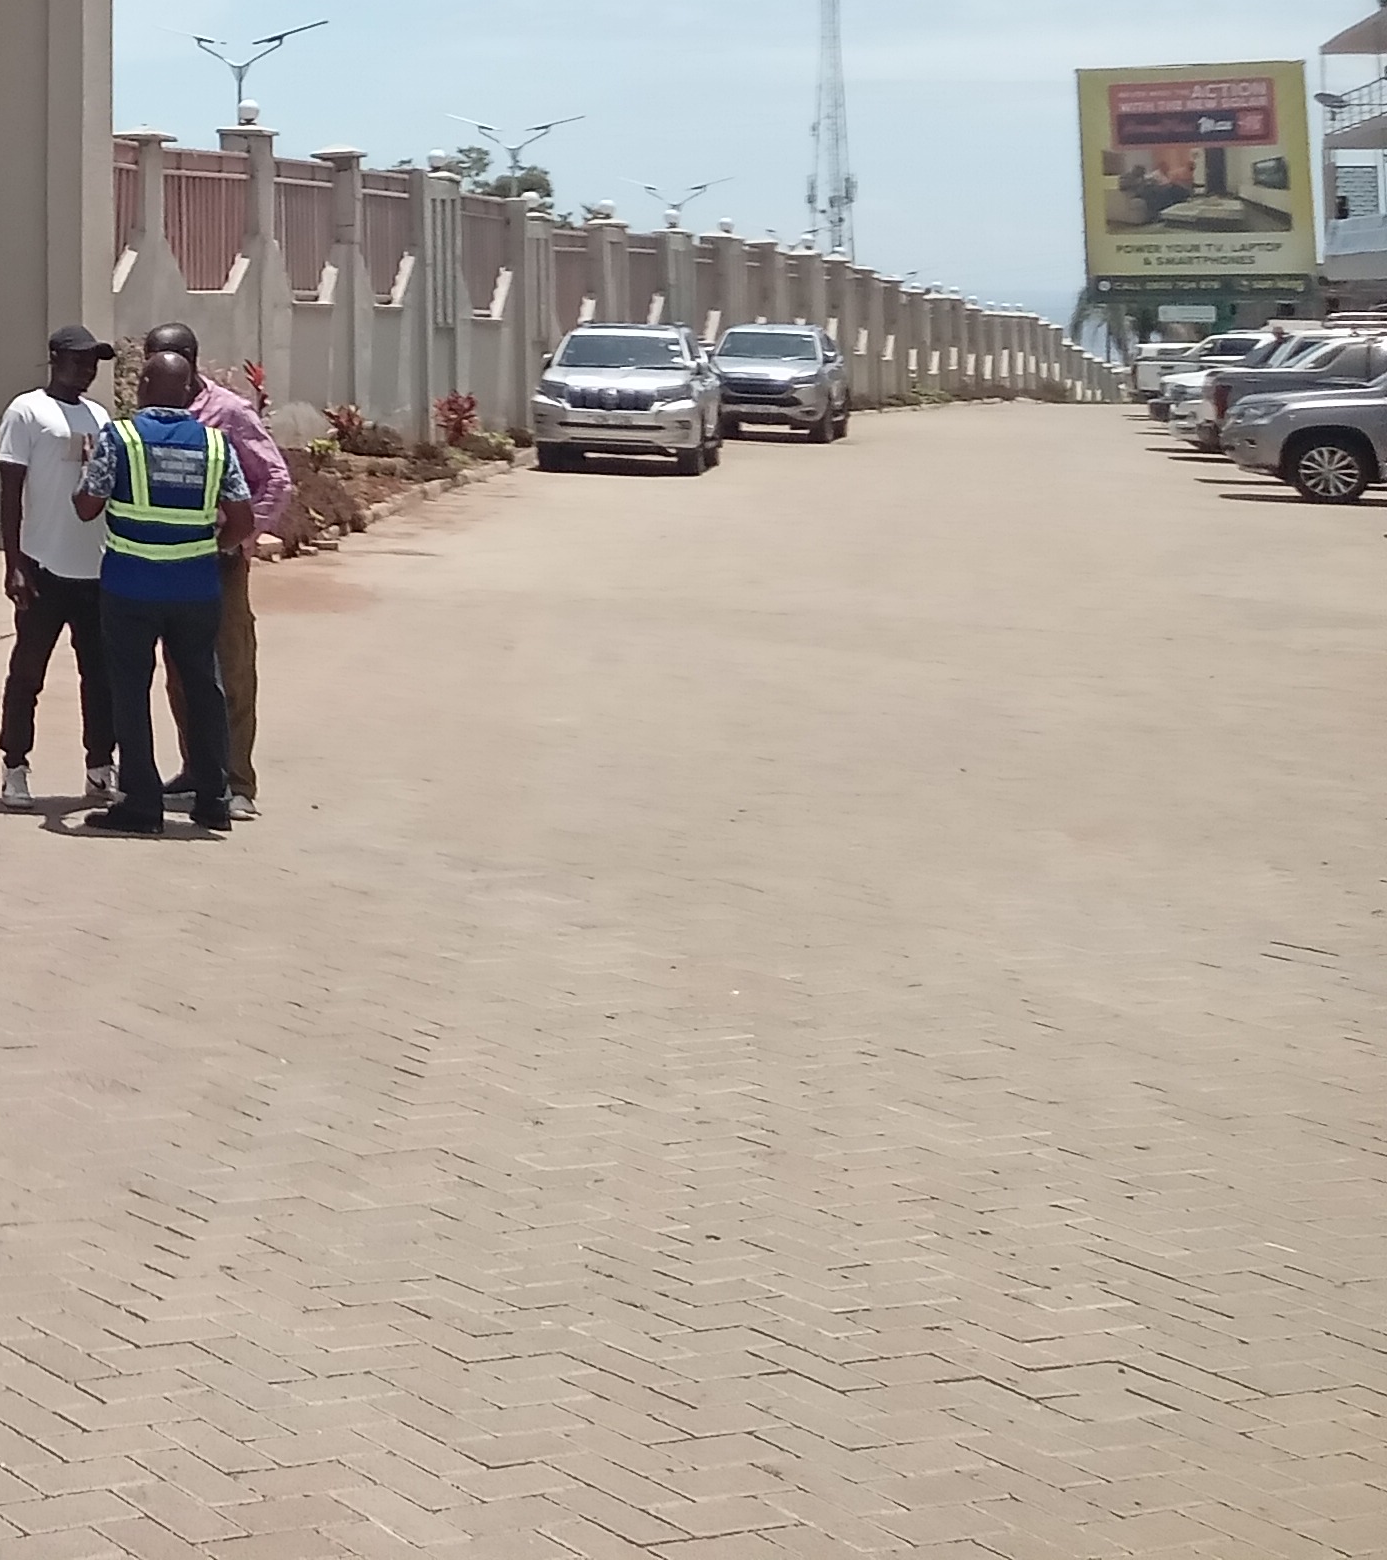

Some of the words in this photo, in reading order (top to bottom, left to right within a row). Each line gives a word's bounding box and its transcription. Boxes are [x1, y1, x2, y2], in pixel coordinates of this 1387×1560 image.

[1191, 82, 1267, 98] ACTION
[1116, 243, 1162, 254] POWER
[1165, 243, 1201, 253] YOUR
[1231, 242, 1284, 253] LAPTOP
[1155, 256, 1256, 266] SMARTPHONES
